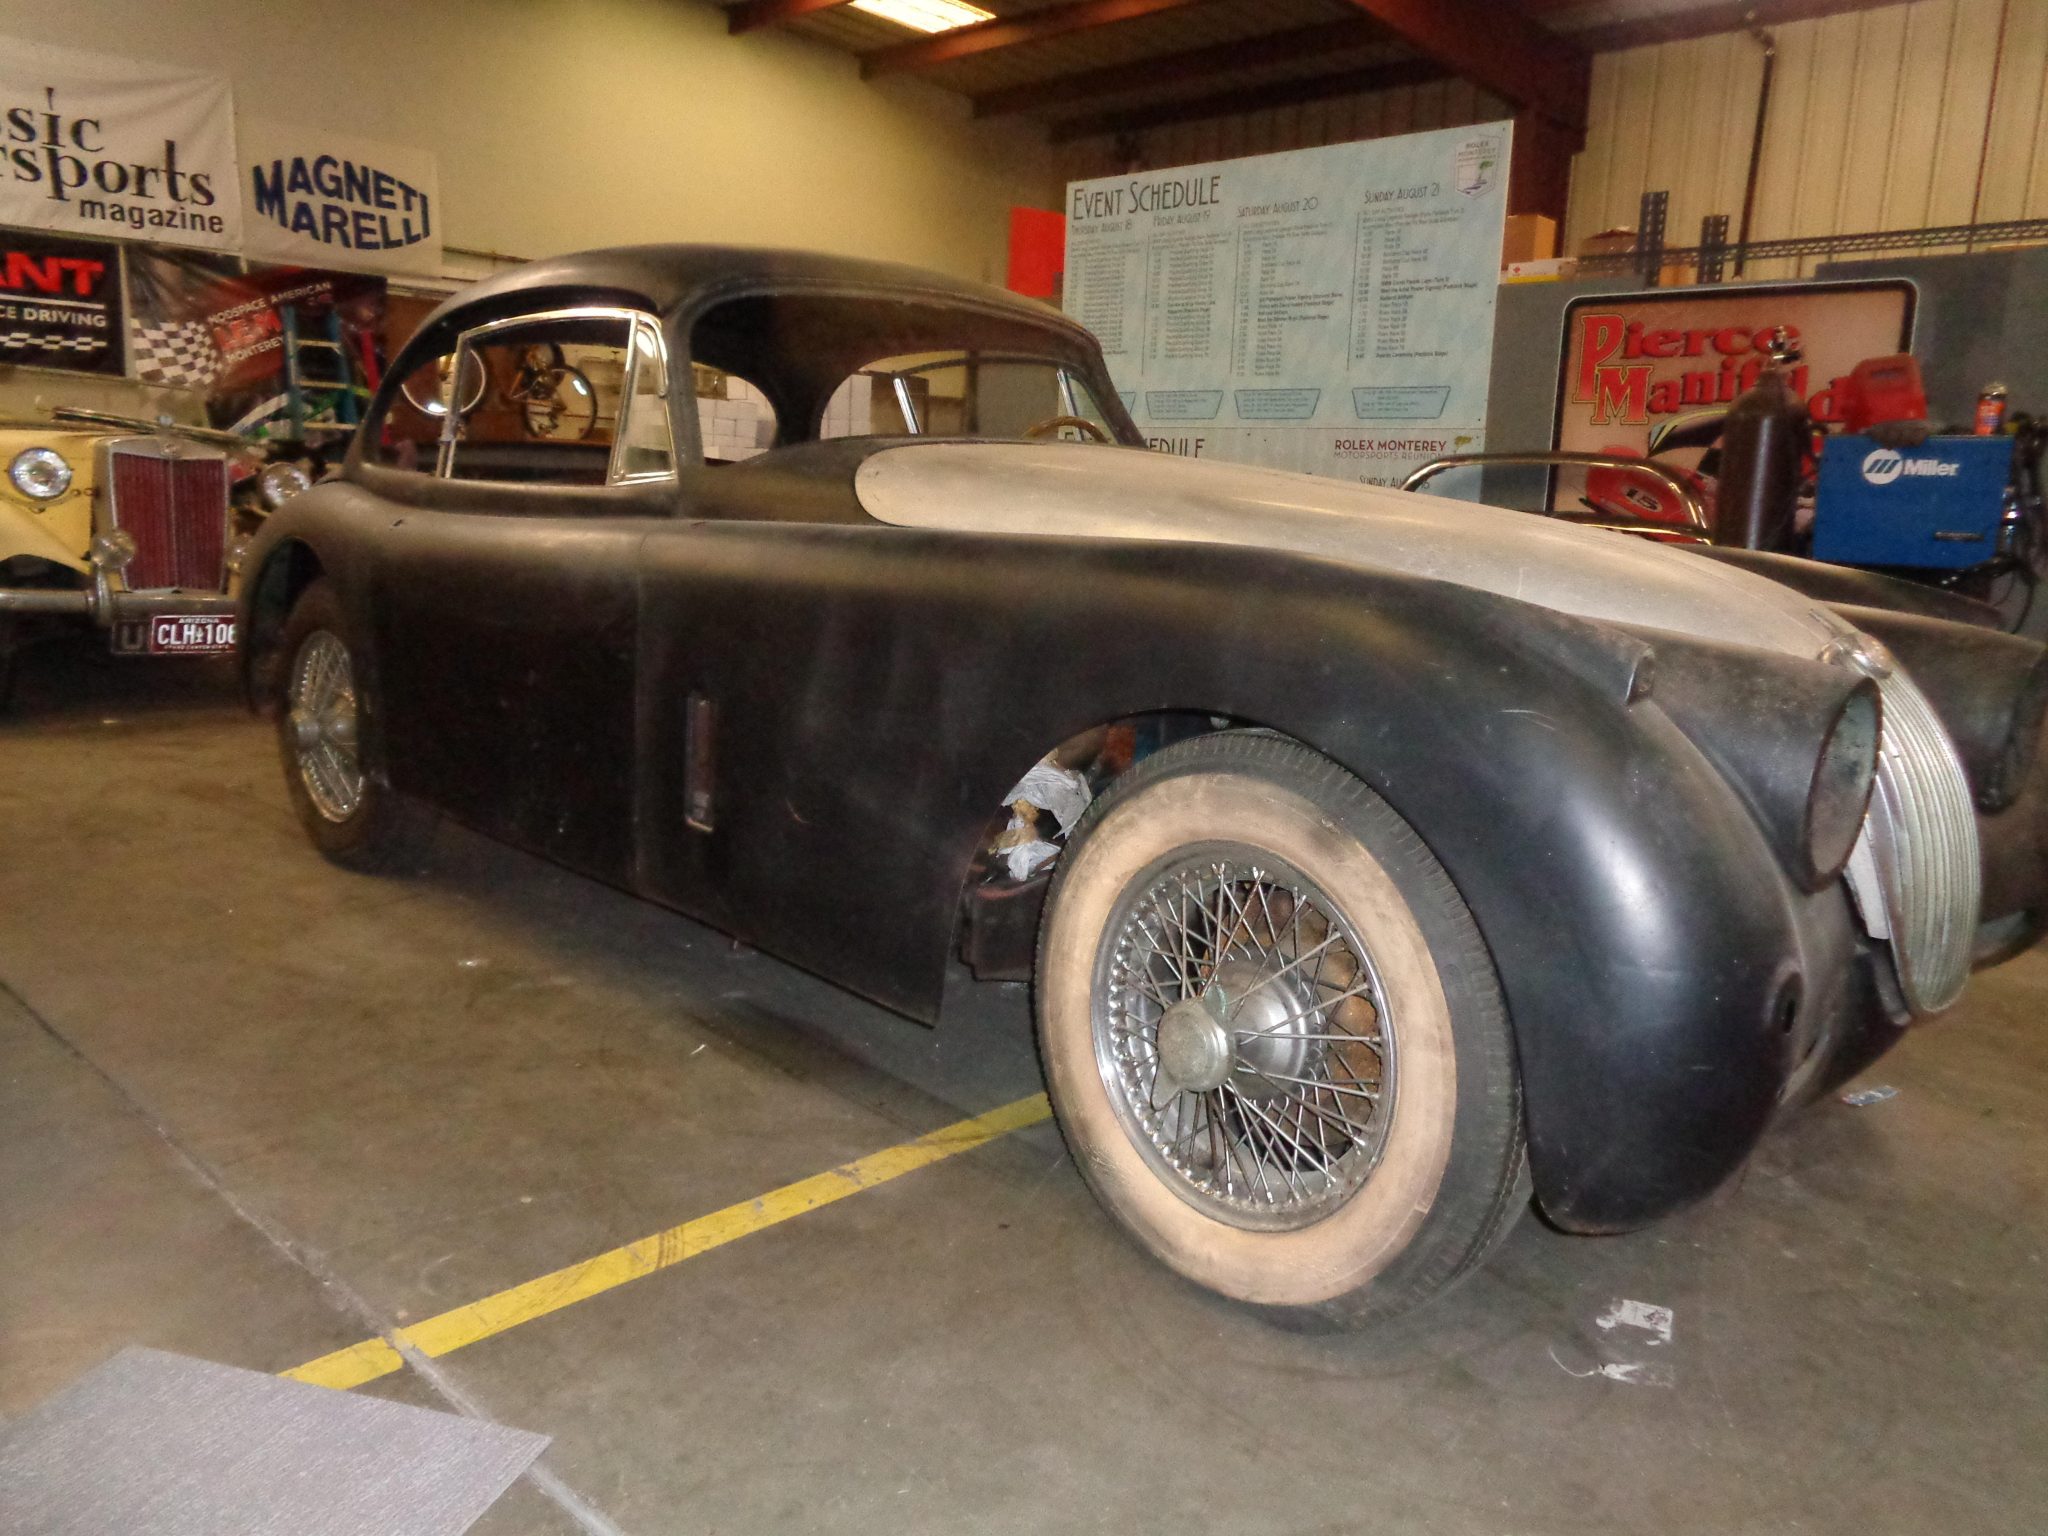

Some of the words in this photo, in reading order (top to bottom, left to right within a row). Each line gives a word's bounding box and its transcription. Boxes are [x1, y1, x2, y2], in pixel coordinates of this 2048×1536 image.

[0, 87, 104, 152] sic
[252, 155, 430, 222] MAGNETI
[1073, 188, 1124, 220] EVENT
[1128, 176, 1221, 214] SCHEDULE
[1364, 189, 1395, 204] SUNDAY
[1397, 185, 1428, 199] AUGUST
[1431, 182, 1441, 197] 21
[80, 200, 223, 233] magazine
[1236, 205, 1270, 217] SATURDAY
[1272, 201, 1300, 214] AUGUST
[1302, 197, 1319, 211] 20
[252, 195, 430, 250] MARELLI
[1153, 215, 1174, 227] FRIDAY
[1176, 213, 1200, 224] AUGUST
[270, 282, 332, 304] AMERICAN
[24, 307, 107, 328] DRIVING
[225, 335, 284, 362] MONTEREY
[1572, 314, 1800, 404] Pierce
[1590, 356, 1850, 425] Manifld
[1146, 438, 1206, 458] EDULE
[1333, 451, 1398, 460] MOTORSPORTS
[1335, 439, 1374, 451] ROLEX
[1377, 440, 1447, 451] MONTEREY
[1904, 459, 1960, 476] Miller
[1359, 474, 1388, 487] SUNDAY
[157, 623, 195, 645] CLH
